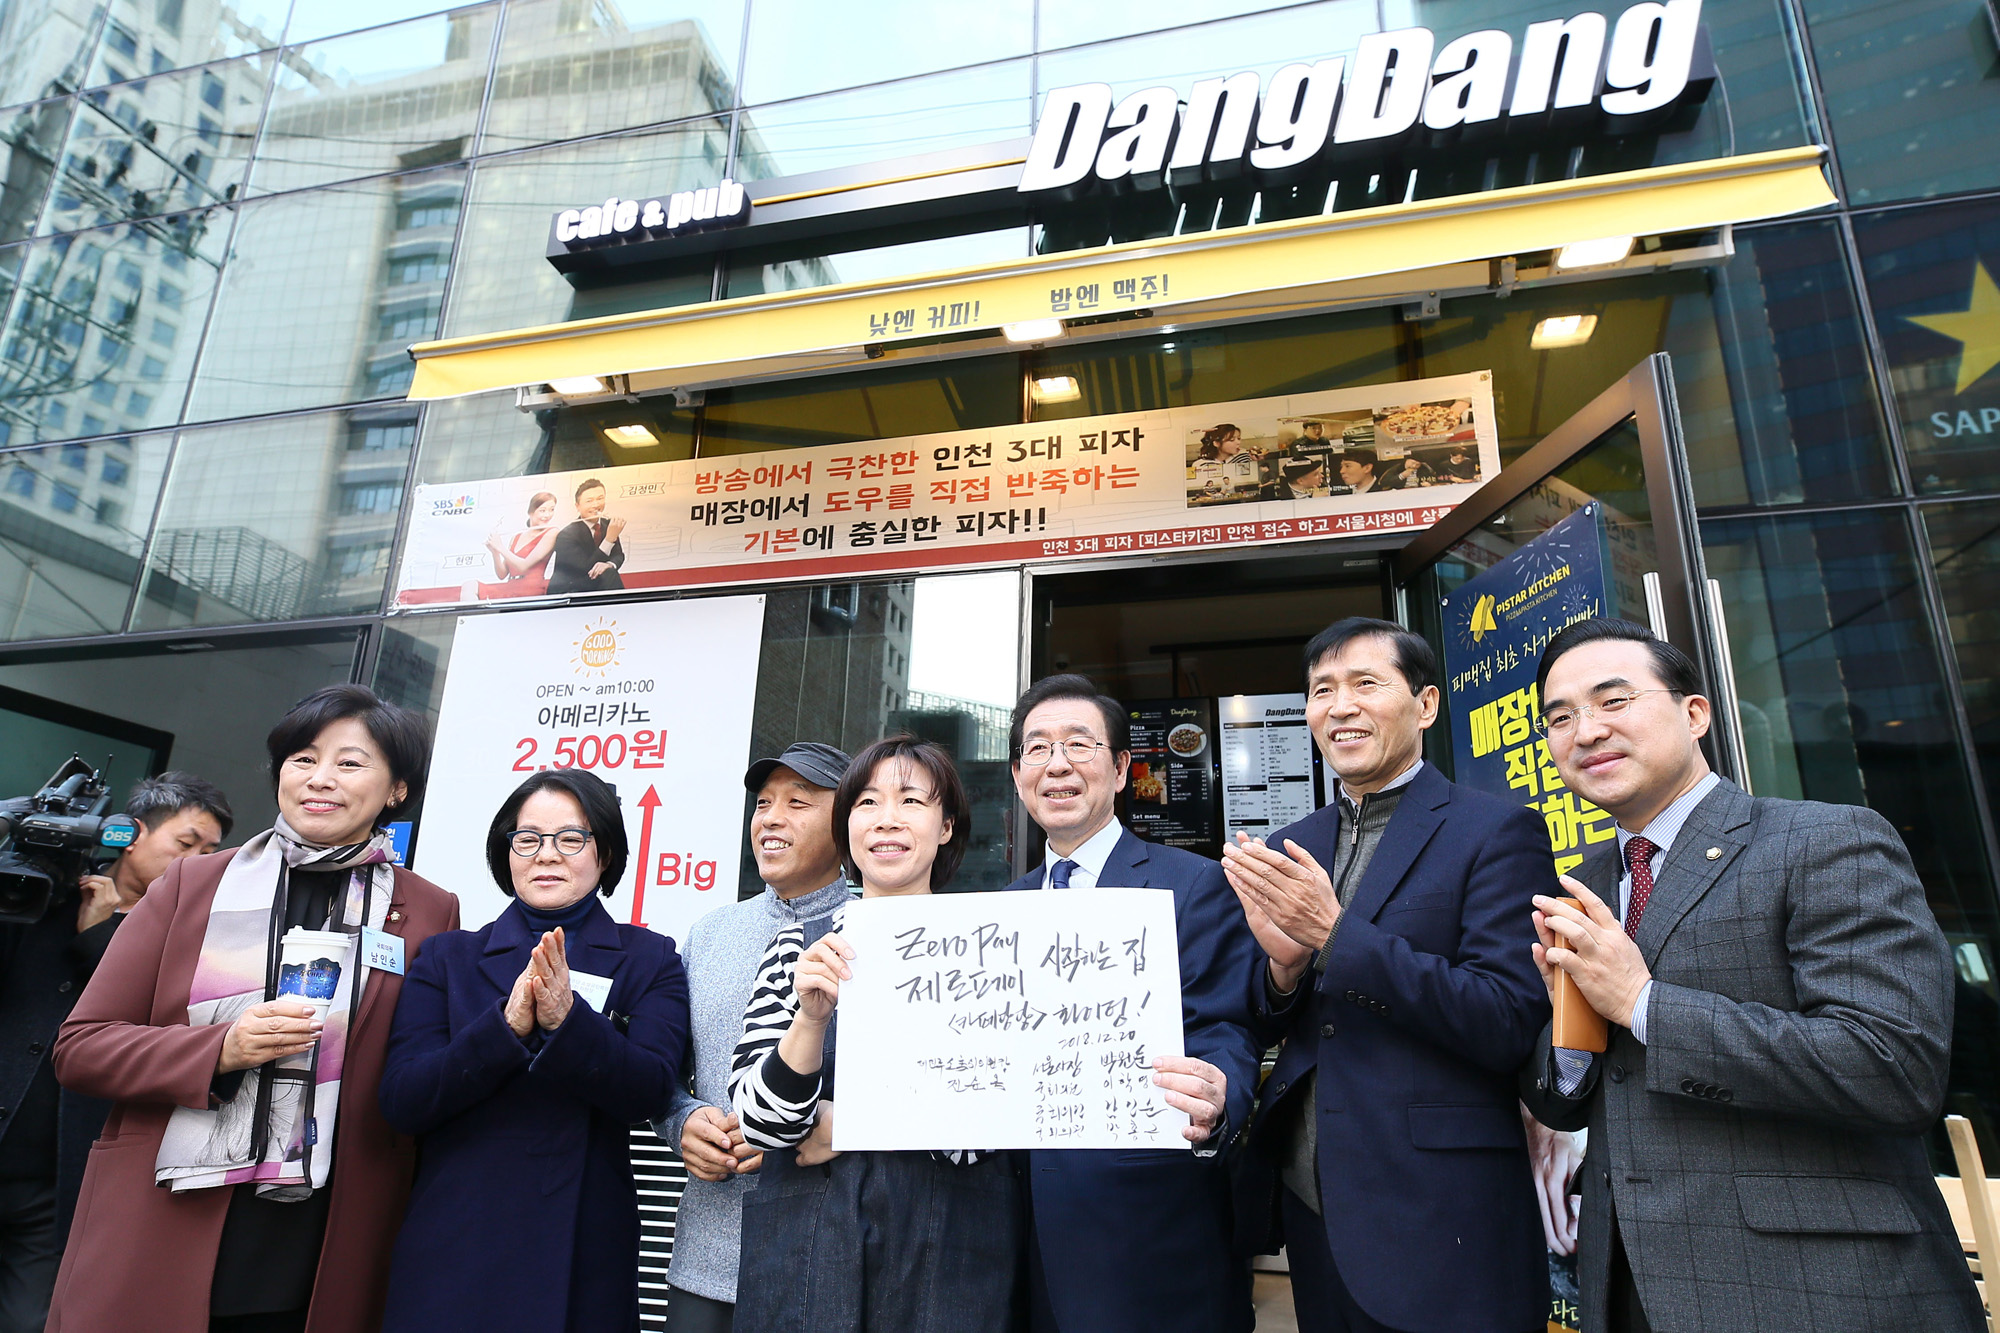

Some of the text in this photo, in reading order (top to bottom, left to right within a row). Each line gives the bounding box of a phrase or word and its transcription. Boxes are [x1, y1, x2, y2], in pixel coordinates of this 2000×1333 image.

[1018, 0, 1701, 193] DangDang
[556, 178, 744, 242] cafe & pub
[1050, 274, 1168, 312] 밤엔 맥주!
[870, 300, 980, 337] 낮엔 커피!
[695, 427, 1144, 494] 방송에서 극찬한 인천 3대 피자
[433, 499, 454, 509] SBS
[628, 484, 657, 496] 김정민
[691, 464, 1140, 526] 매장에서 도우를 직접 반죽하는
[431, 507, 473, 516] CNBC
[744, 507, 1046, 555] 기본에 충실한 피자!!
[1042, 539, 1069, 555] 인천
[1074, 538, 1099, 552] 3대
[1104, 535, 1133, 550] 피자
[1138, 527, 1221, 549] [피스타키친]
[1227, 525, 1256, 541] 인천
[1261, 521, 1292, 538] 접수
[1298, 519, 1329, 534] 하고
[1335, 511, 1414, 531] 서울시청에
[1496, 564, 1571, 616] PISTAR KITCHEN
[583, 648, 615, 665] MORNING
[585, 633, 614, 649] GOOD
[1452, 656, 1492, 692] 피맥집
[1496, 644, 1520, 673] 최초
[536, 684, 574, 699] OPEN
[595, 679, 655, 696] am10:00
[537, 702, 651, 729] 아메리카노
[1265, 708, 1306, 717] DangDang
[103, 830, 133, 842] OBS
[656, 852, 717, 891] Big
[894, 922, 1019, 968] Zero Pay
[1040, 925, 1147, 983] 시작하는 집
[895, 968, 1025, 1004] 제로페이
